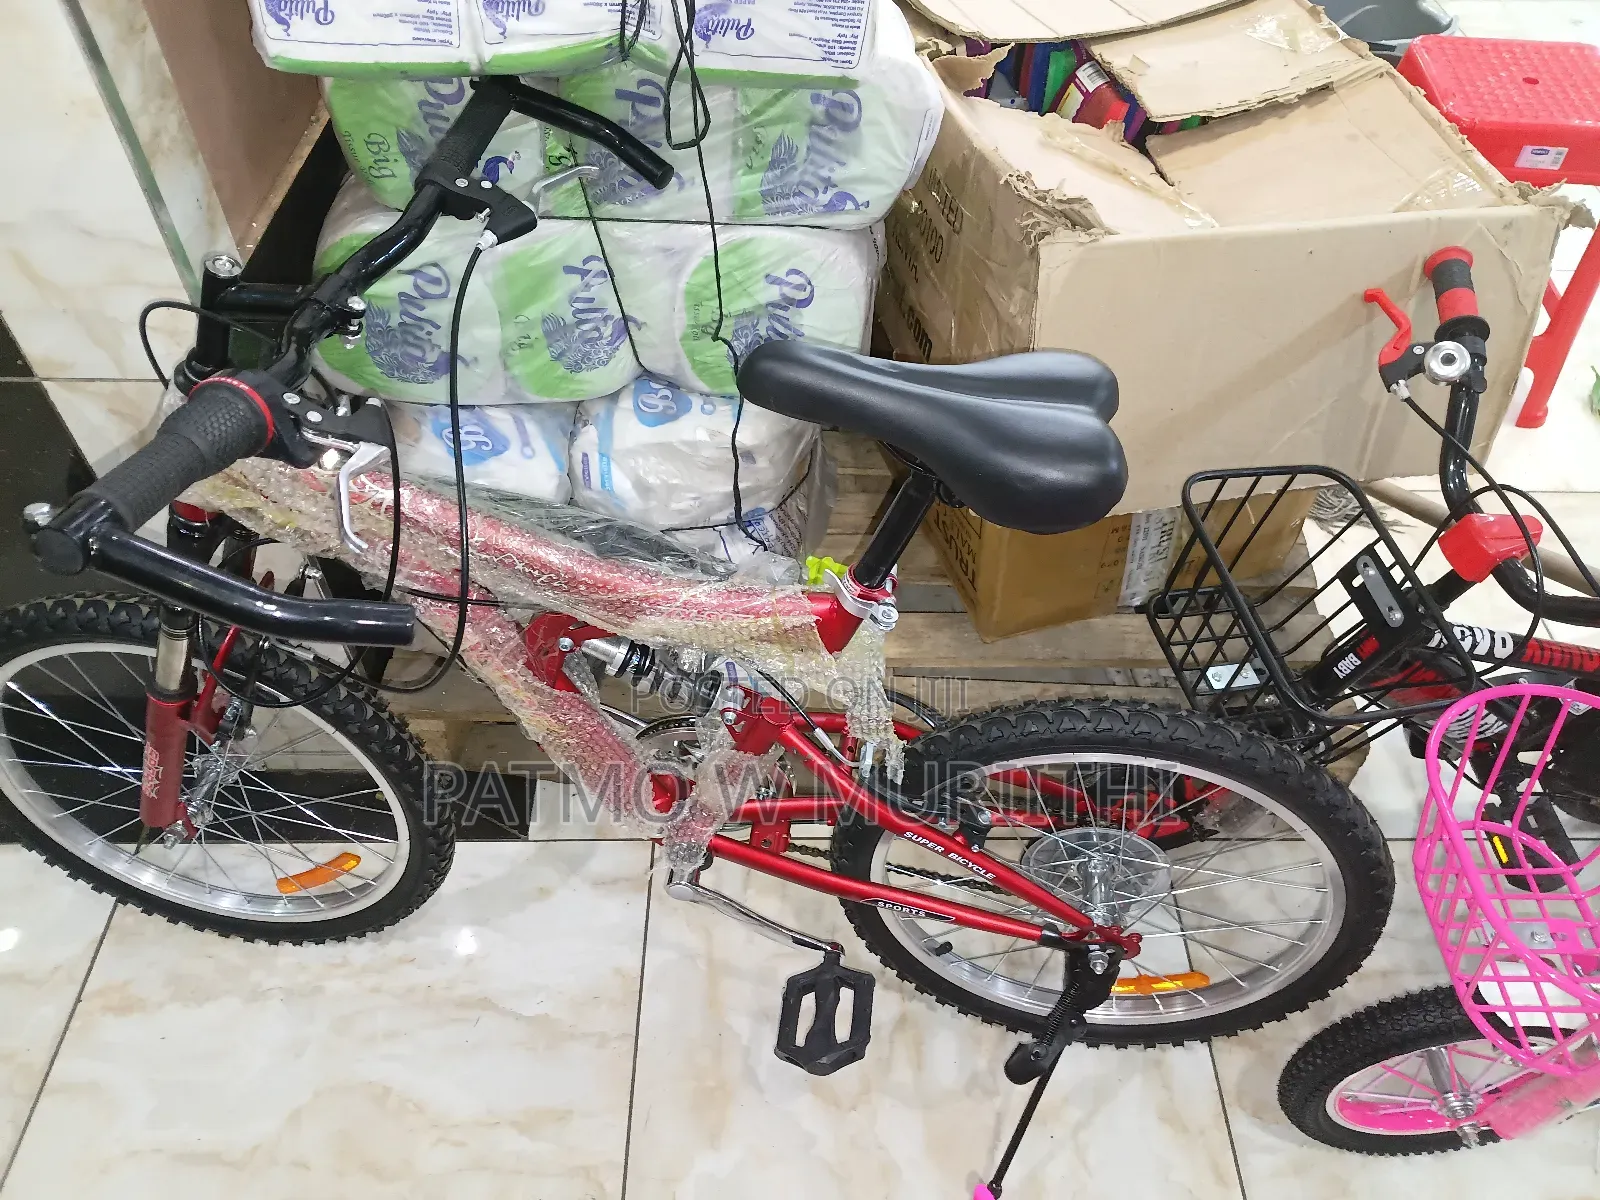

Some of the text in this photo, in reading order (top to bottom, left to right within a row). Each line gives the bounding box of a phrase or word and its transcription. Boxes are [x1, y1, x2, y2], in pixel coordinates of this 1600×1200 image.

[364, 132, 398, 179] Big
[1333, 652, 1361, 680] BABY
[903, 831, 996, 880] SUPER BICYCLE
[877, 901, 926, 917] SPORTS
